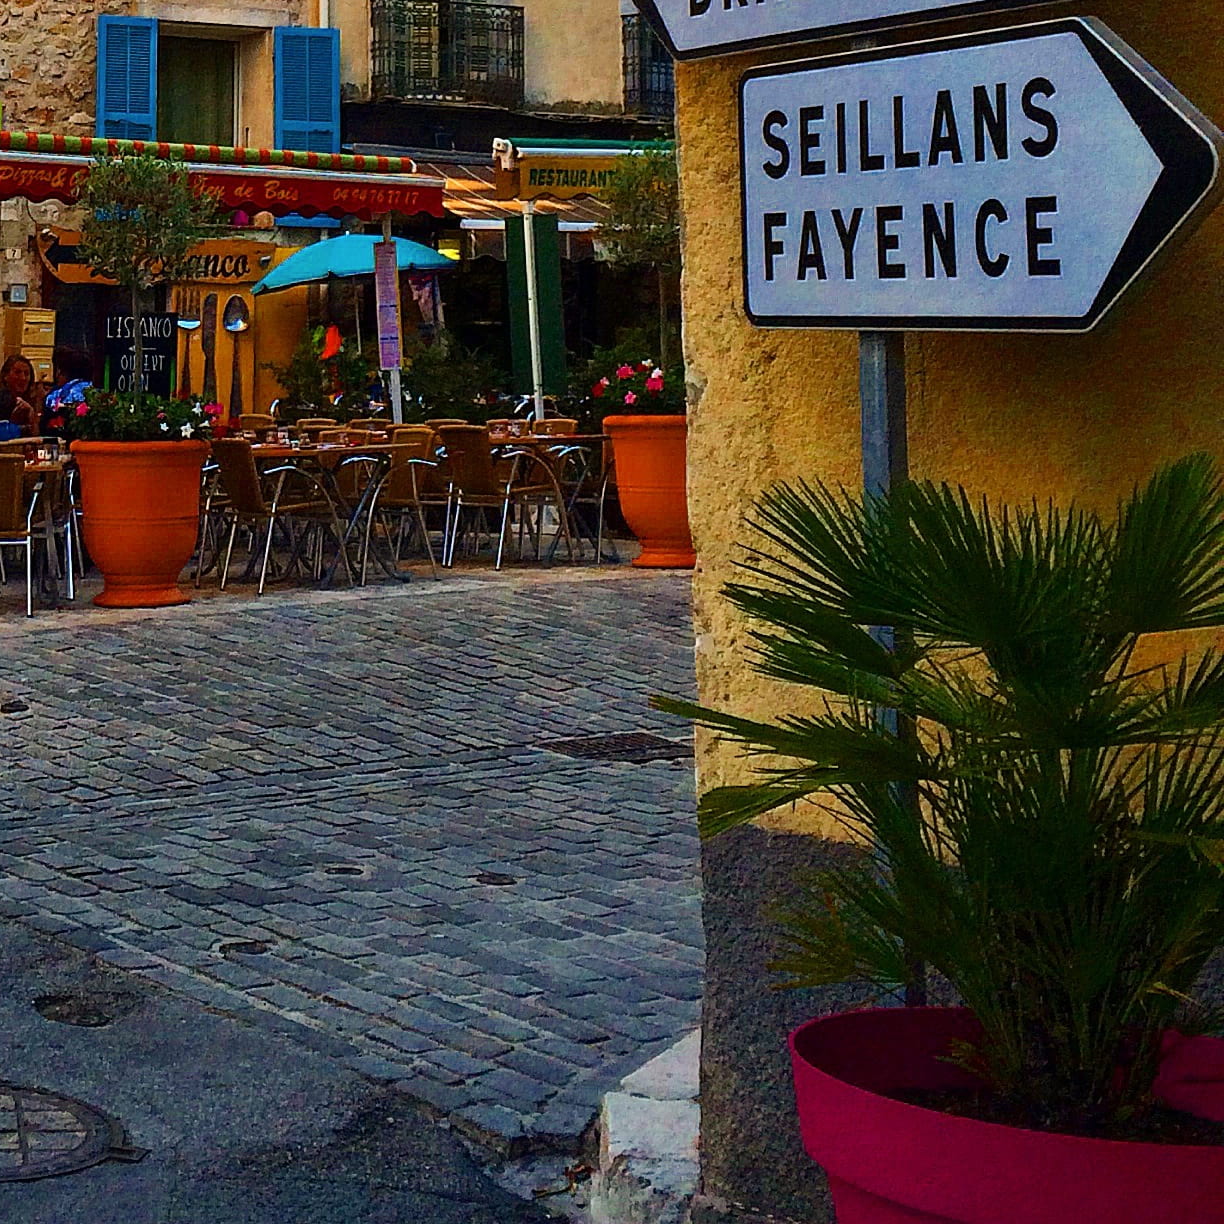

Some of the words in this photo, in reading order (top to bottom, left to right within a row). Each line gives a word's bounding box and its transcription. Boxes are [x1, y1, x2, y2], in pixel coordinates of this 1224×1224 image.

[763, 76, 1059, 179] SEILLANS
[234, 182, 253, 198] de
[265, 180, 299, 201] Bois
[763, 195, 1063, 282] FAYENCE
